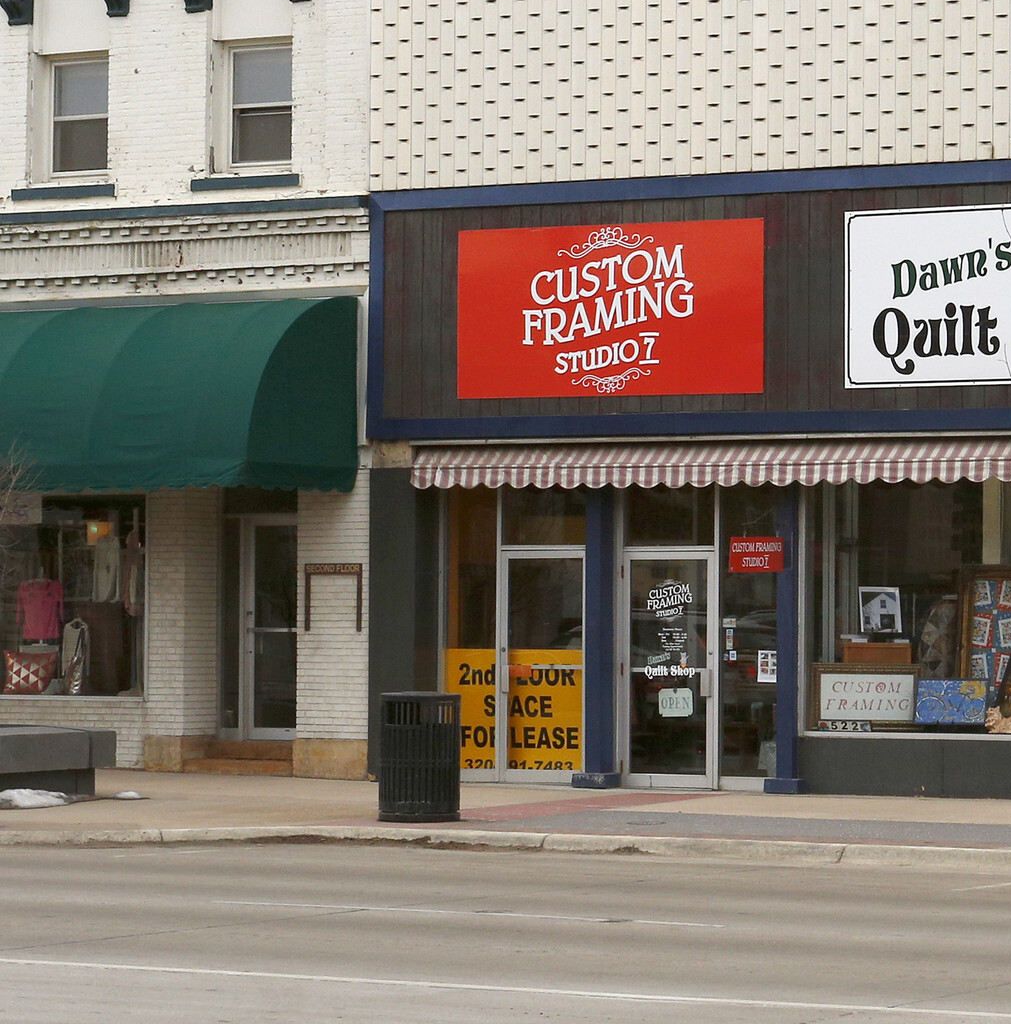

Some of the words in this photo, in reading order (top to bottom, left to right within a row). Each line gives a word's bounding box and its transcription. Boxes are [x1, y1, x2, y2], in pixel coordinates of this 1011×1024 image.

[531, 244, 685, 305] CUSTOM
[522, 280, 694, 345] FRAMING
[873, 303, 1001, 375] Quilt
[555, 339, 640, 375] STUDIO
[732, 542, 755, 552] CUSTOM
[755, 542, 782, 552] FRAMING
[336, 564, 360, 572] FLOOR
[742, 557, 764, 567] STUDIO
[649, 584, 690, 599] CUSTOM
[647, 593, 693, 610] FRAMING
[655, 607, 678, 617] STUDIO
[459, 663, 496, 685] 2nd
[644, 665, 669, 679] Quilt
[670, 665, 696, 678] Shop
[832, 681, 902, 693] CUSTOM
[483, 694, 553, 718] SACE
[661, 697, 690, 709] OPEN
[825, 698, 910, 711] FRAMING
[831, 721, 859, 731] 522
[511, 727, 579, 749] LEASE
